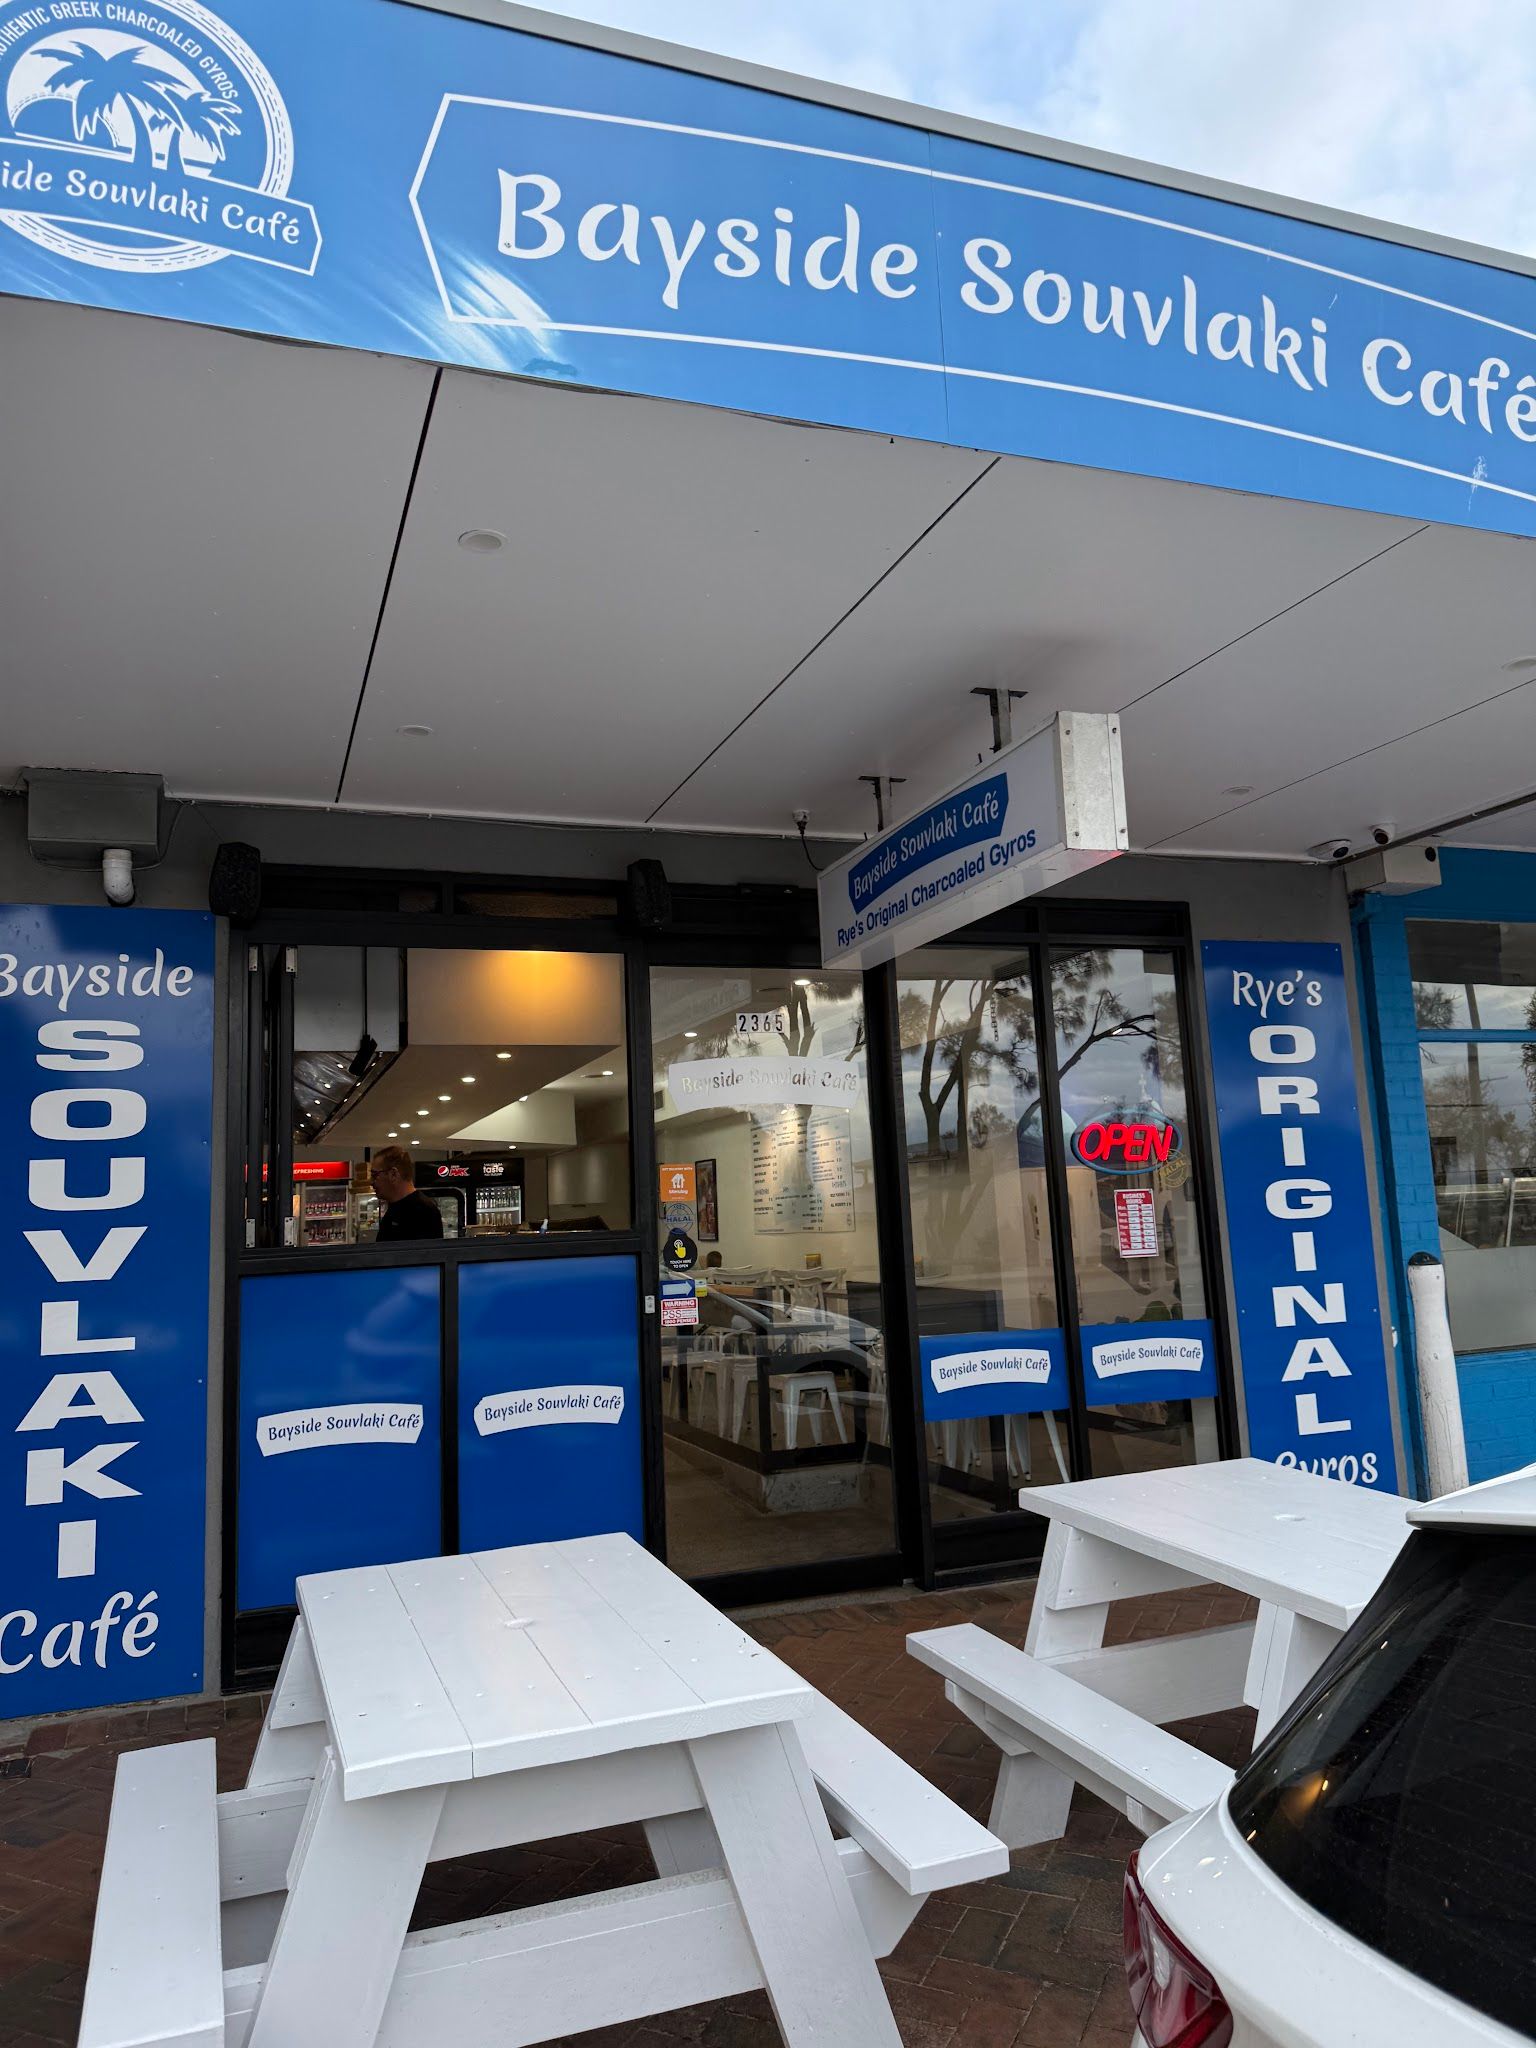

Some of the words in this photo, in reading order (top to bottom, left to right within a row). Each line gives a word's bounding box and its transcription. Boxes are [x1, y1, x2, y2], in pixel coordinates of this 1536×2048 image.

[0, 8, 51, 56] THENTIC
[50, 1, 103, 20] GREEK
[106, 4, 200, 59] CHARCOALED
[200, 56, 239, 101] GYROS
[66, 169, 209, 224] Souvlaki
[221, 203, 301, 245] Café
[497, 167, 919, 310] Bayside
[960, 238, 1328, 391] Souvlaki
[1362, 337, 1536, 443] Café
[853, 846, 898, 900] Bayside
[900, 811, 958, 863] Souvlaki
[962, 790, 999, 829] Café
[837, 919, 864, 947] Rye's
[866, 893, 909, 932] Original
[911, 851, 986, 908] Charcoaled
[989, 828, 1037, 866] Gyros
[0, 948, 194, 1012] Bayside
[1232, 969, 1324, 1019] Rye's
[738, 1014, 783, 1032] 2365
[682, 1069, 744, 1096] Bayside
[750, 1066, 817, 1088] Souvlaki
[821, 1071, 858, 1093] Café
[1078, 1122, 1174, 1162] OPEN
[665, 1214, 691, 1223] HALAL
[1249, 1024, 1353, 1436] ORIGINAL
[15, 1019, 149, 1579] SOUVLAKI
[662, 1310, 682, 1320] PSS
[939, 1362, 978, 1380] Bayside
[980, 1356, 1023, 1371] Souvlaki
[1025, 1358, 1048, 1371] Café
[1100, 1350, 1136, 1367] Bayside
[1138, 1345, 1178, 1359] Souvlaki
[1180, 1346, 1201, 1360] Café
[268, 1416, 322, 1441] Bayside
[326, 1413, 385, 1430] Souvlaki
[389, 1413, 421, 1429] Café
[484, 1393, 534, 1421] Bayside
[537, 1395, 590, 1412] Souvlaki
[593, 1395, 621, 1410] Café
[0, 1590, 159, 1674] Café
